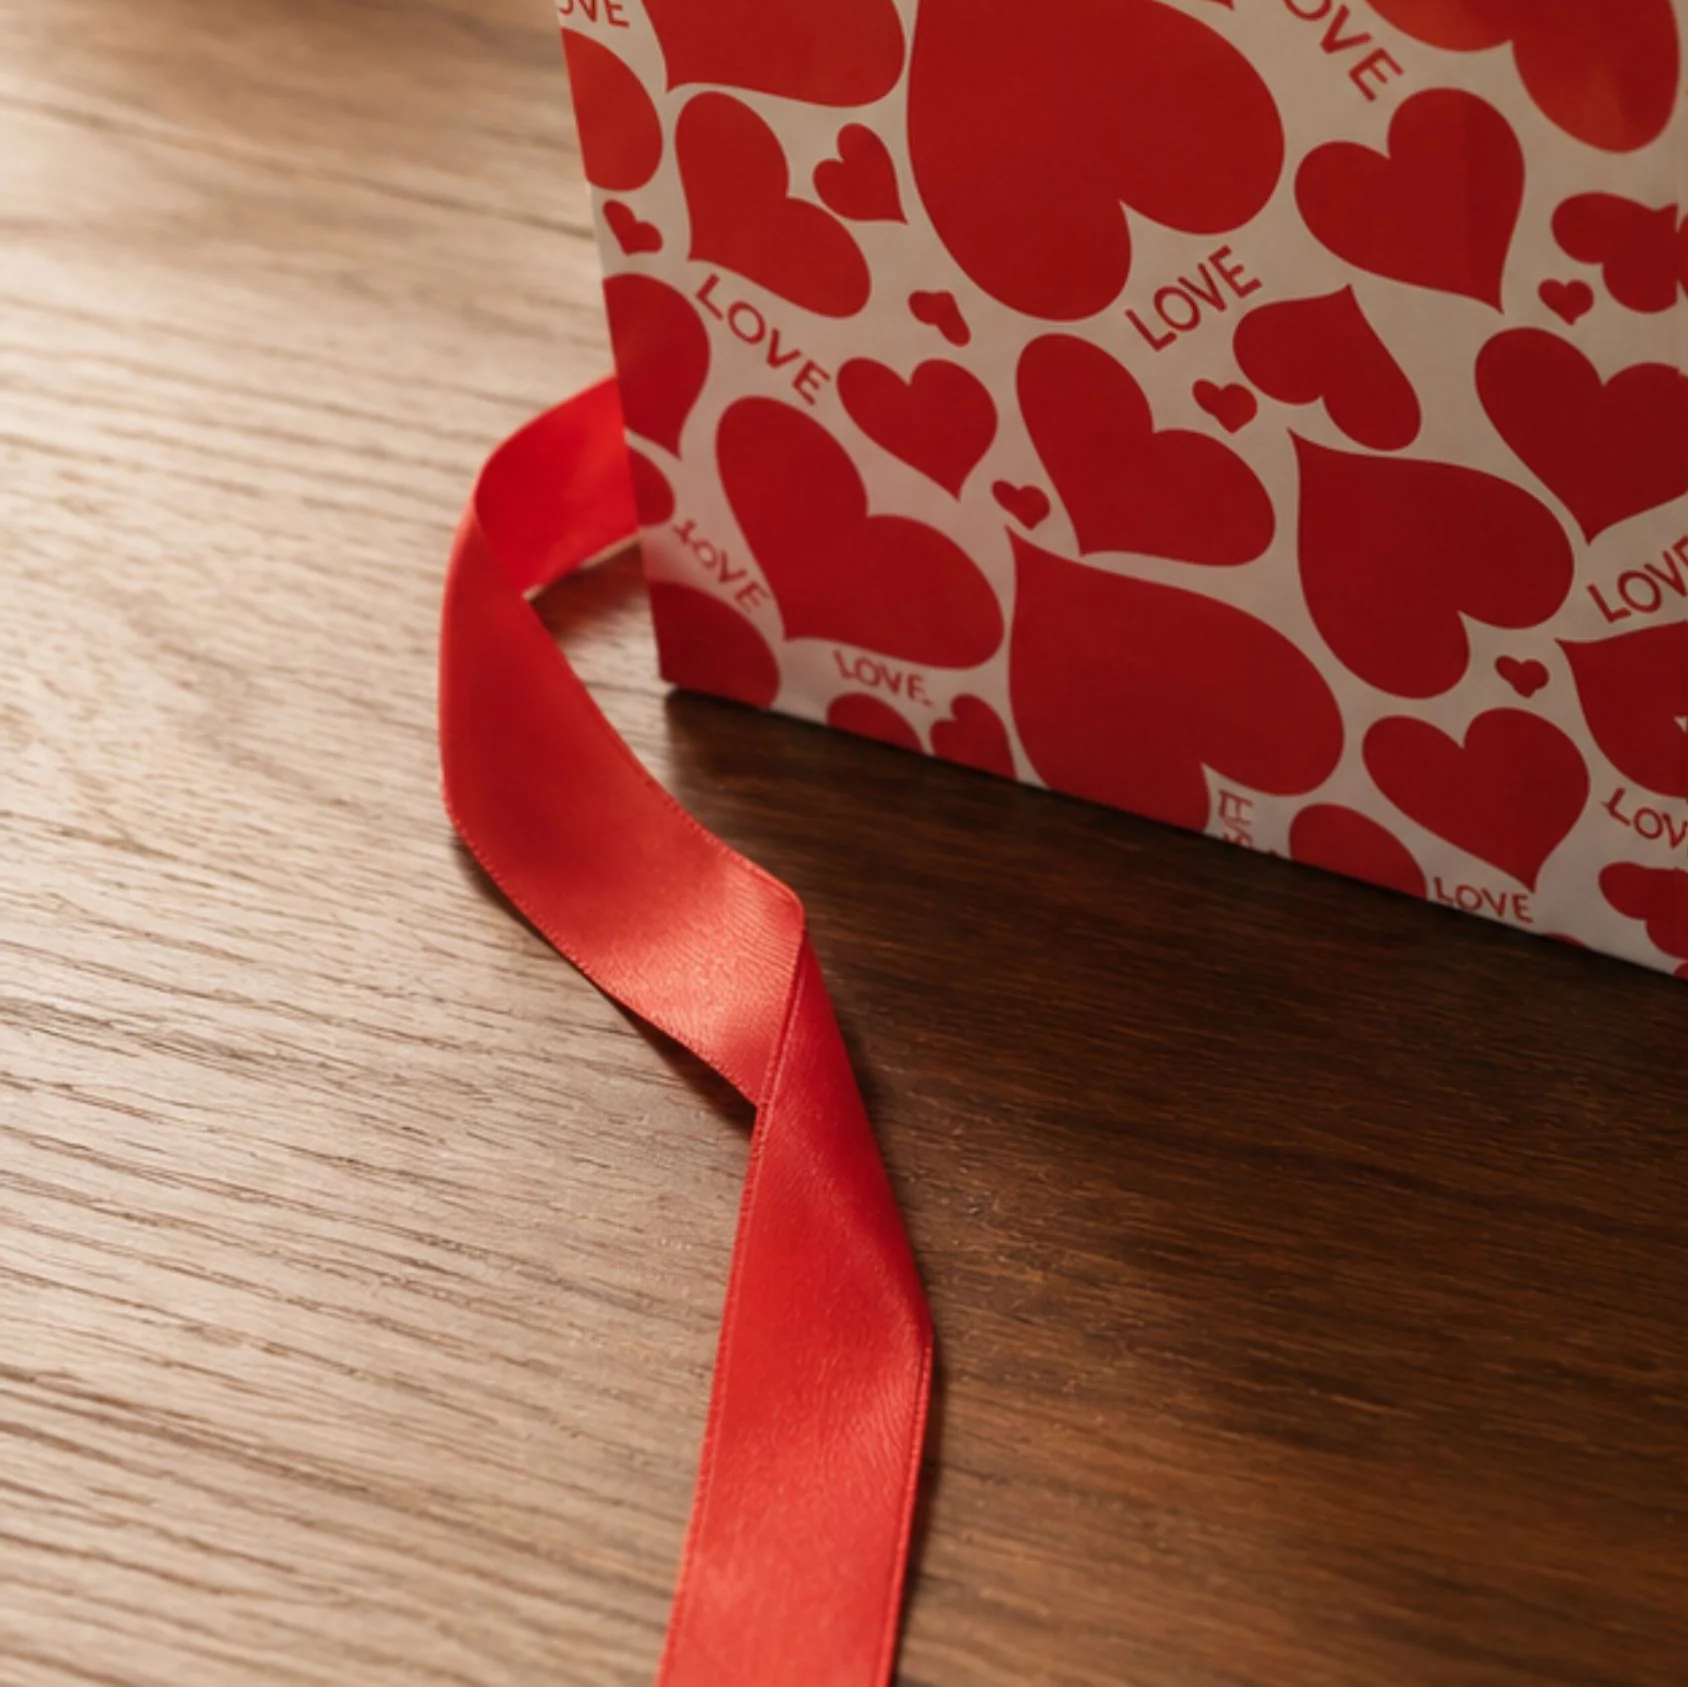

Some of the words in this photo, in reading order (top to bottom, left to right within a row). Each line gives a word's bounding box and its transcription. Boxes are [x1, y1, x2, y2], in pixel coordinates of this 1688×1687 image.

[695, 272, 831, 406] LOVE
[1124, 244, 1262, 352] LOVE
[1433, 876, 1534, 924] LOVE
